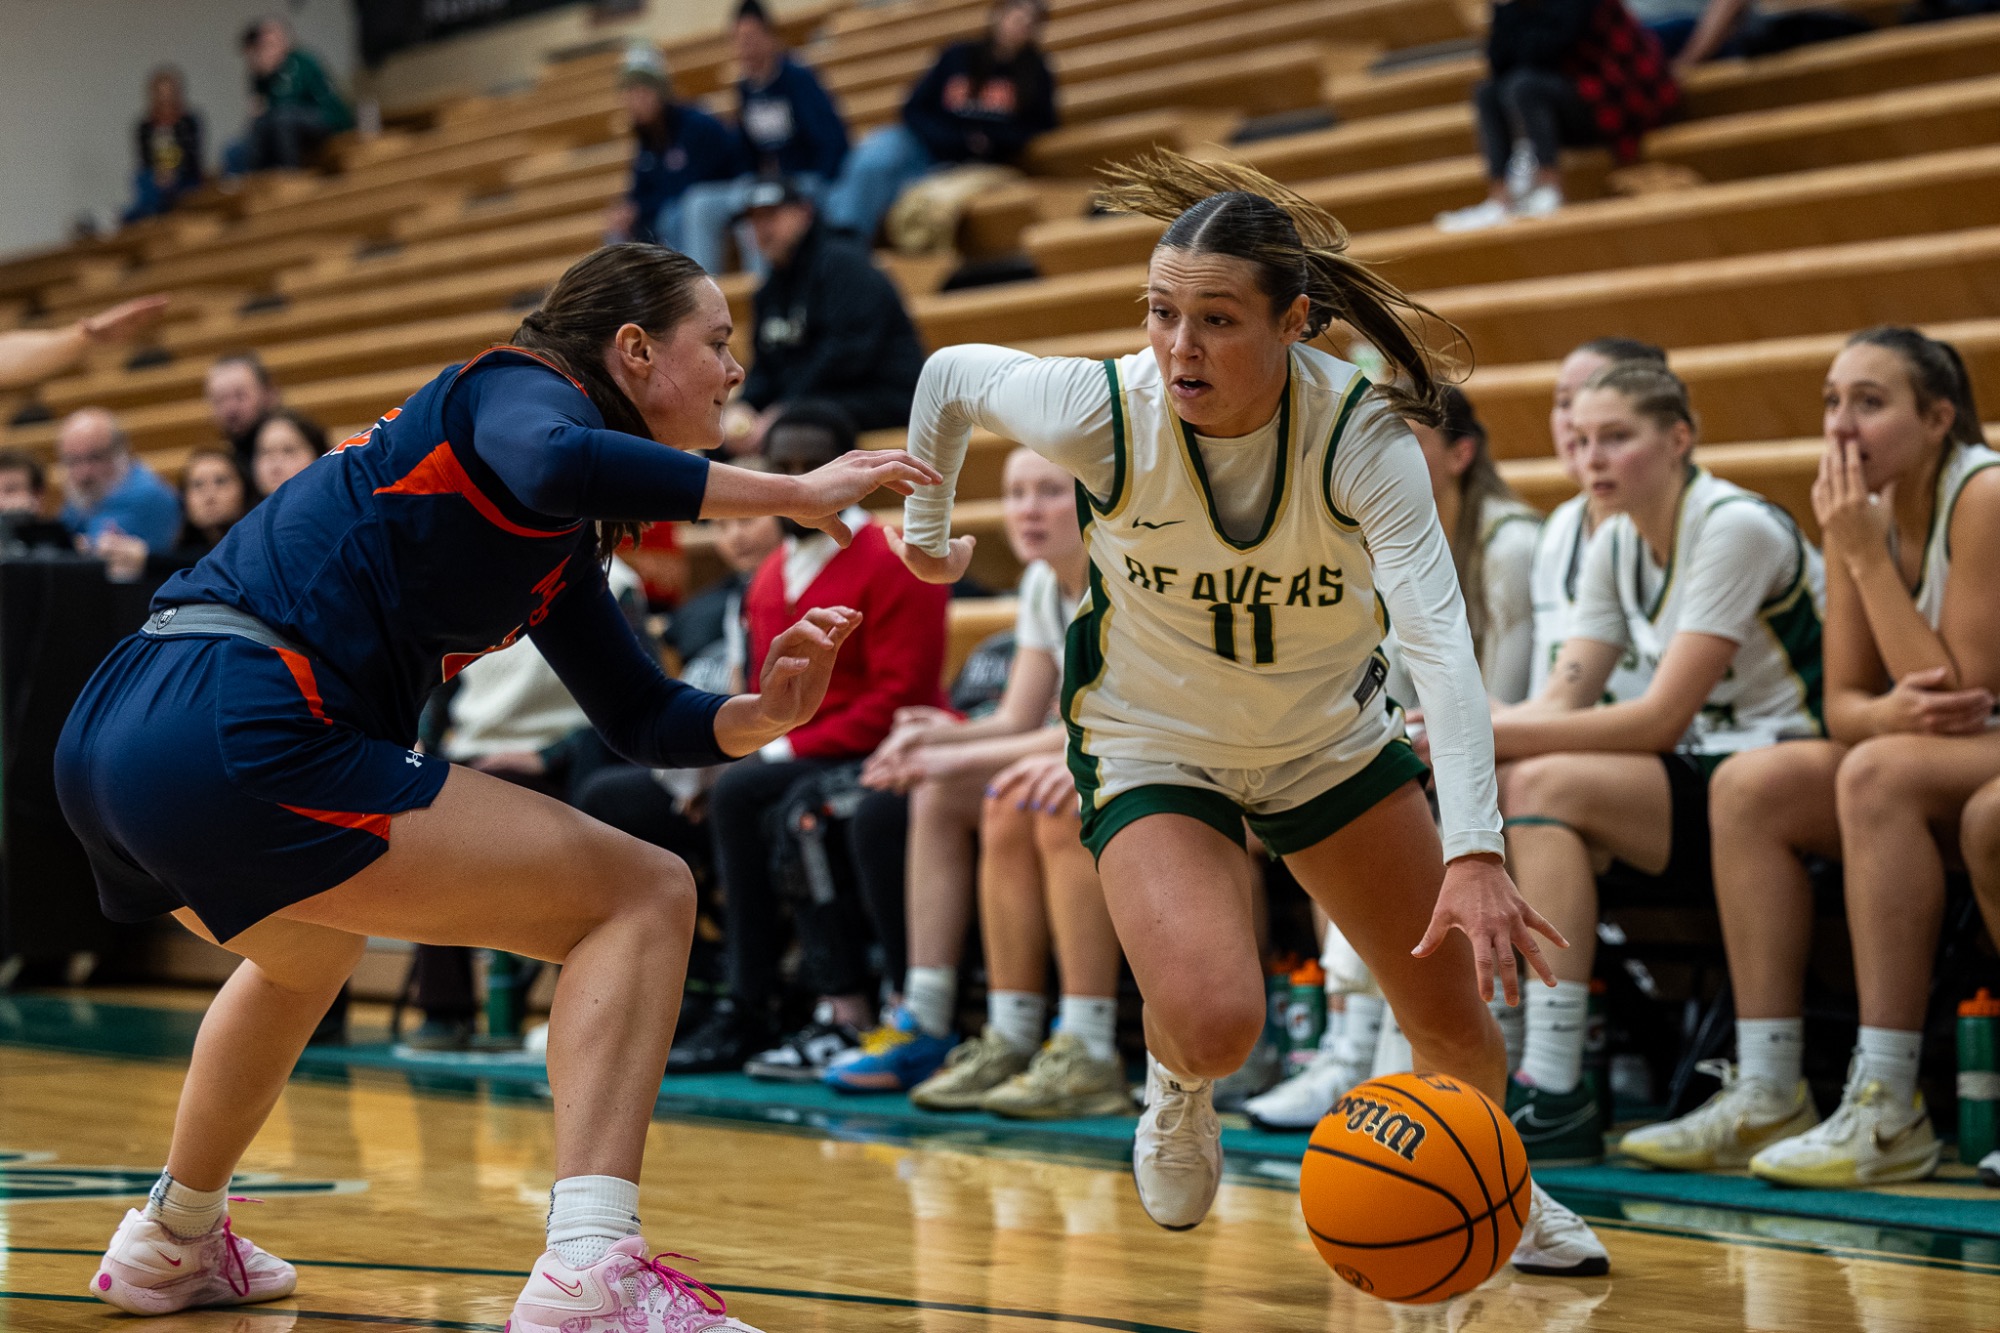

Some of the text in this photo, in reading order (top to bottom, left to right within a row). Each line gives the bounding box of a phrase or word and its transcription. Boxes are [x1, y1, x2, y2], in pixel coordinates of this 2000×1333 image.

[1123, 553, 1345, 608] BEAVERS
[1207, 601, 1279, 667] 11
[1326, 1095, 1427, 1163] Wilso
